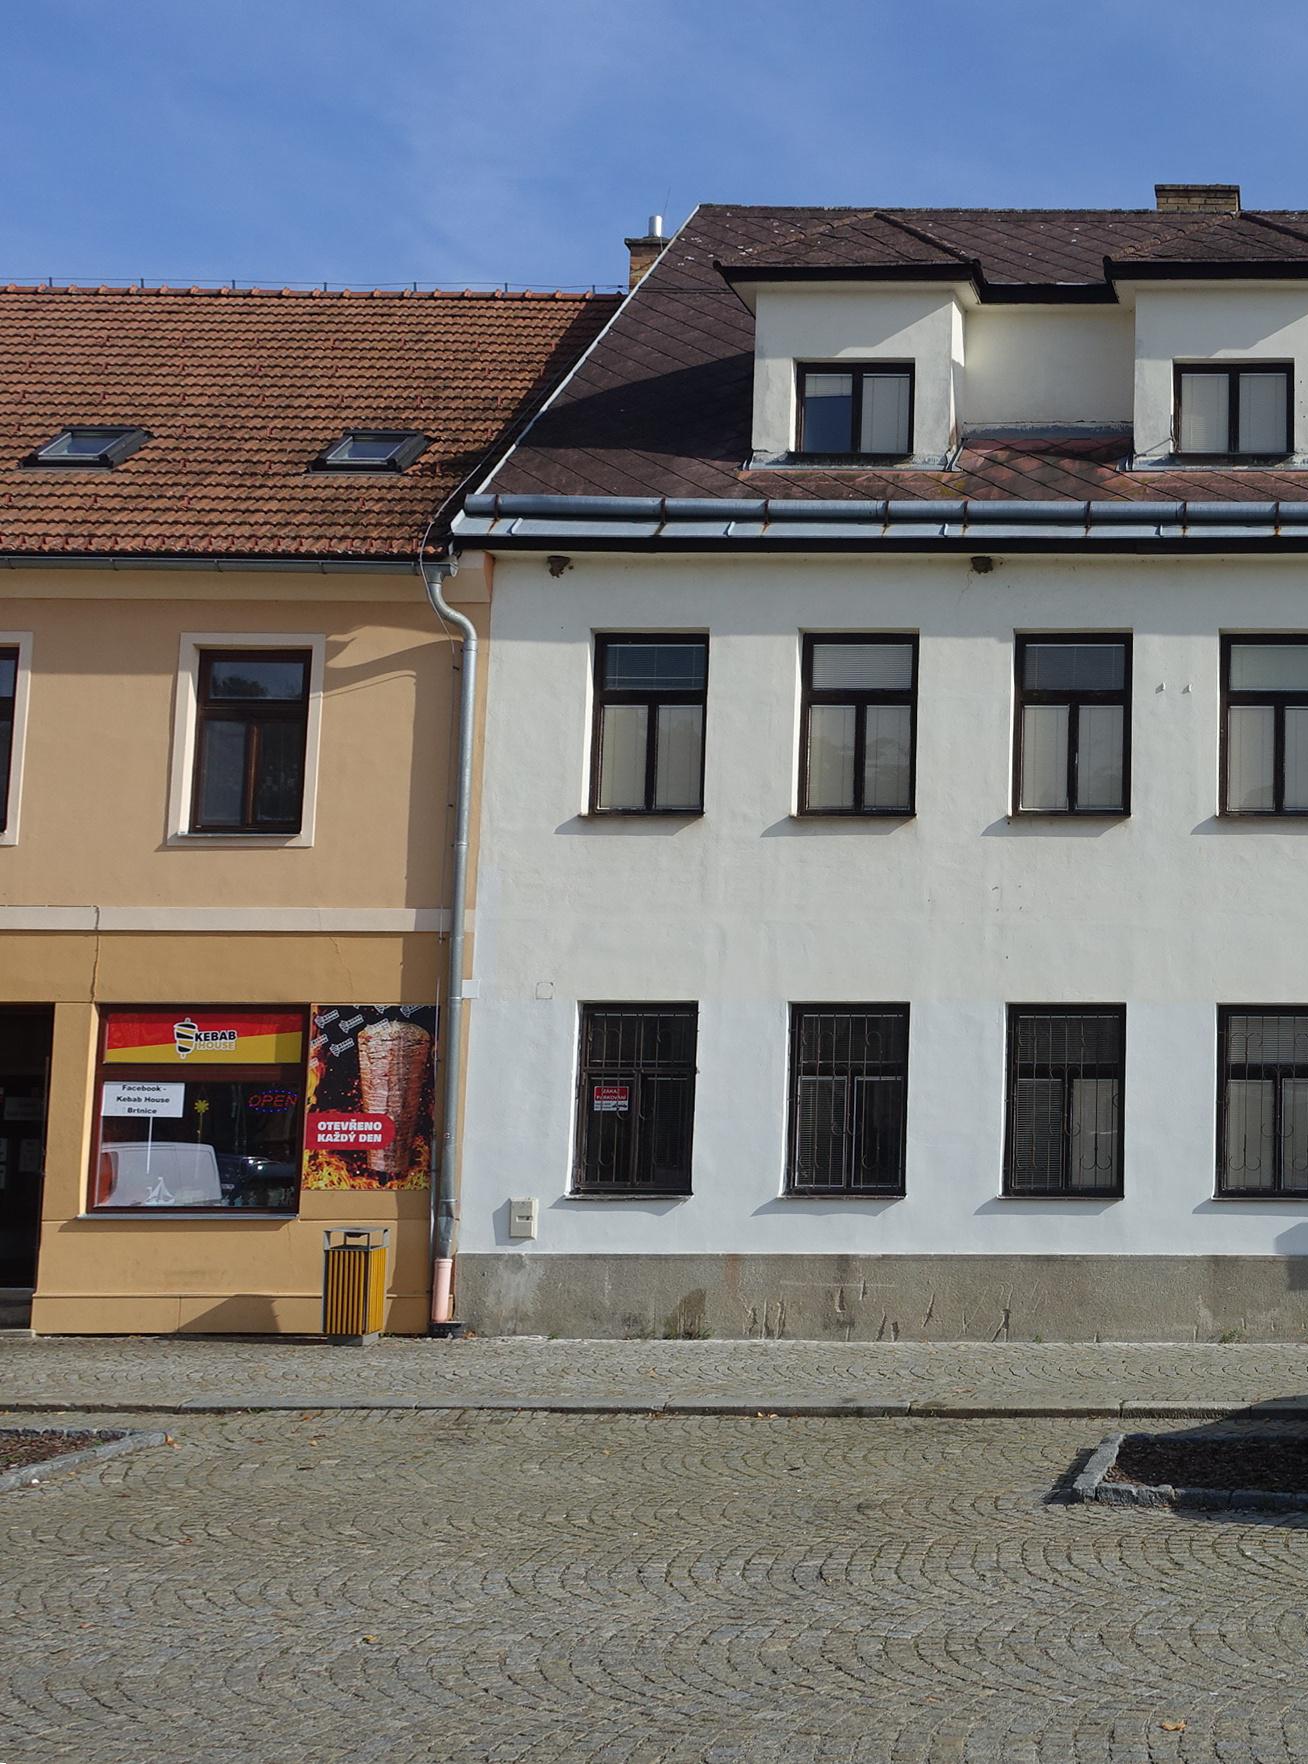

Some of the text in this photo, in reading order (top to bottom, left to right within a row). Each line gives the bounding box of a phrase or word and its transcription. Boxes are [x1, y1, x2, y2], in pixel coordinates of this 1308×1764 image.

[194, 1031, 236, 1042] KEBAB
[196, 1042, 235, 1050] HOUSE
[122, 1084, 161, 1092] Facebook
[144, 1096, 170, 1104] House
[248, 1094, 300, 1107] OPEN
[317, 1118, 382, 1131] OTEVŘENO
[317, 1131, 382, 1143] KAŽDÝ DEN
